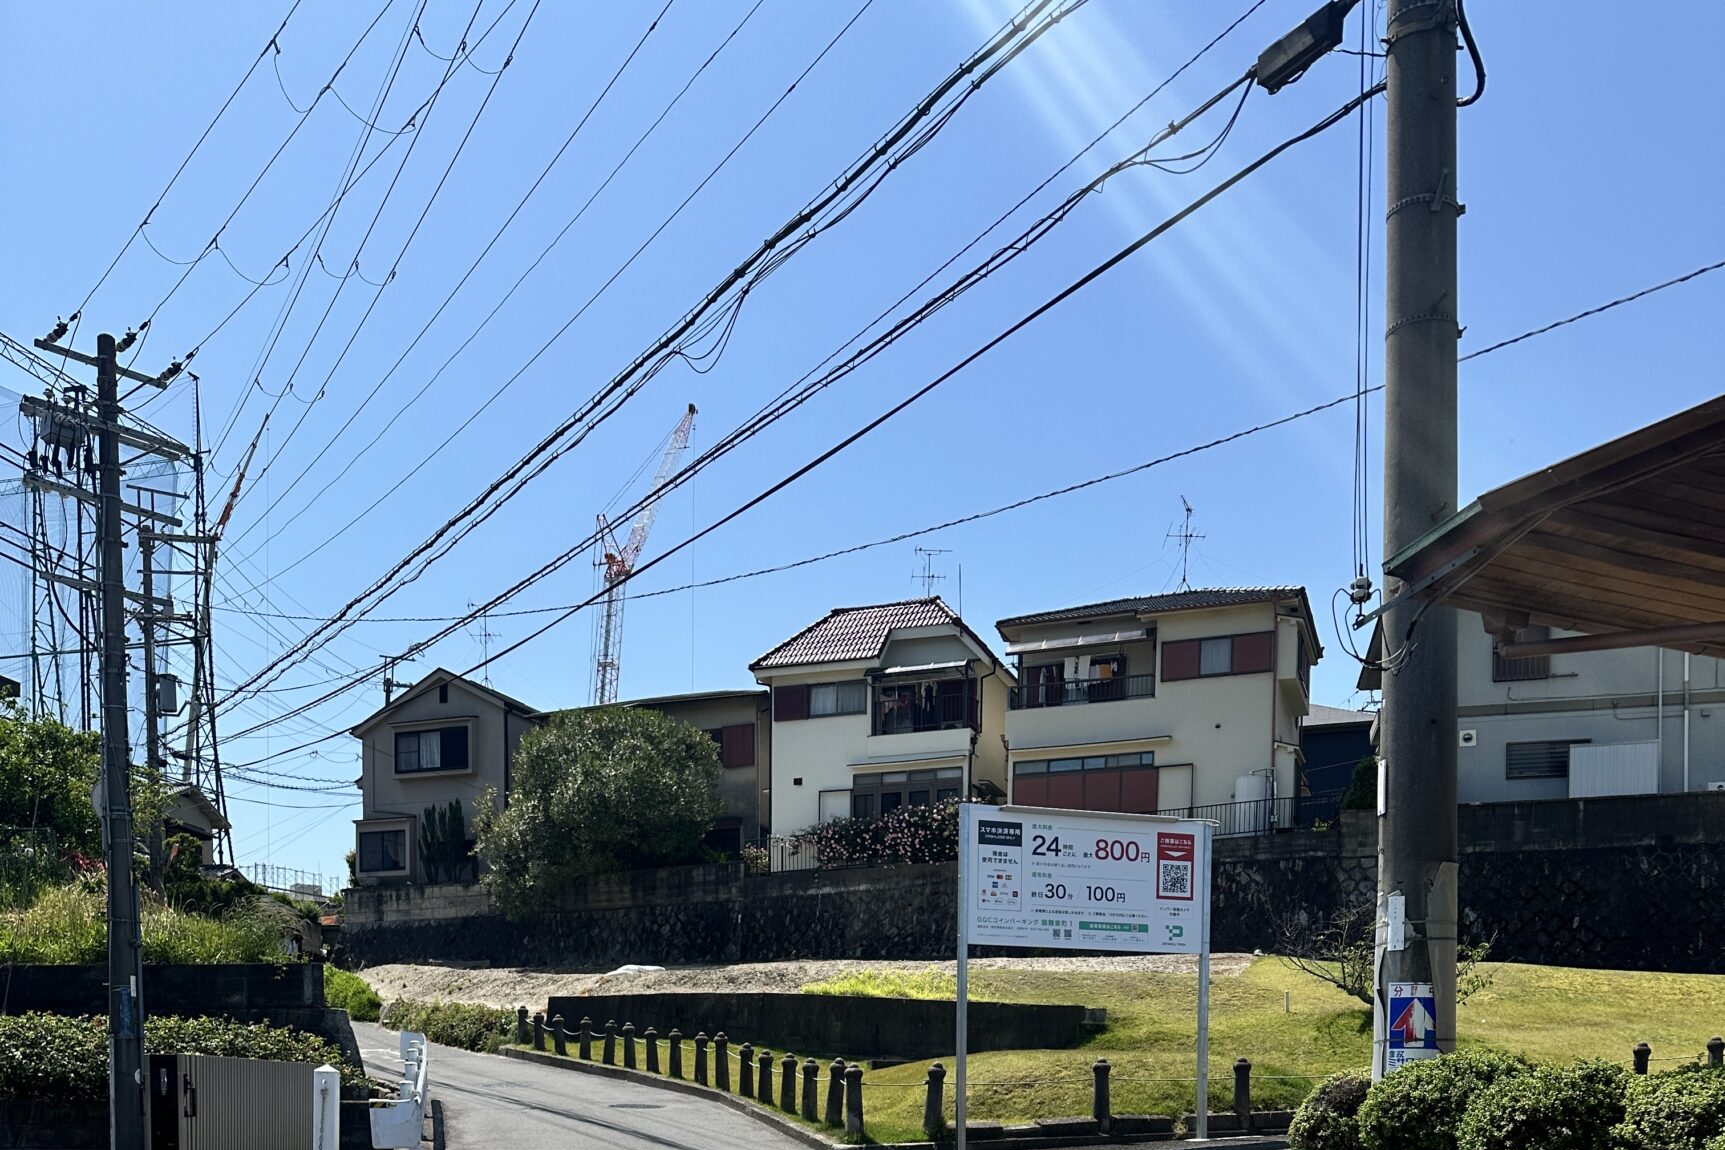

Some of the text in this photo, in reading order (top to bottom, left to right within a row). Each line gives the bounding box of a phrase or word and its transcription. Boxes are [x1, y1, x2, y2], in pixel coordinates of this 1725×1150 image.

[980, 827, 1020, 836] スマホ決済専用
[1032, 835, 1061, 857] 24
[982, 857, 1018, 865] 使用できません
